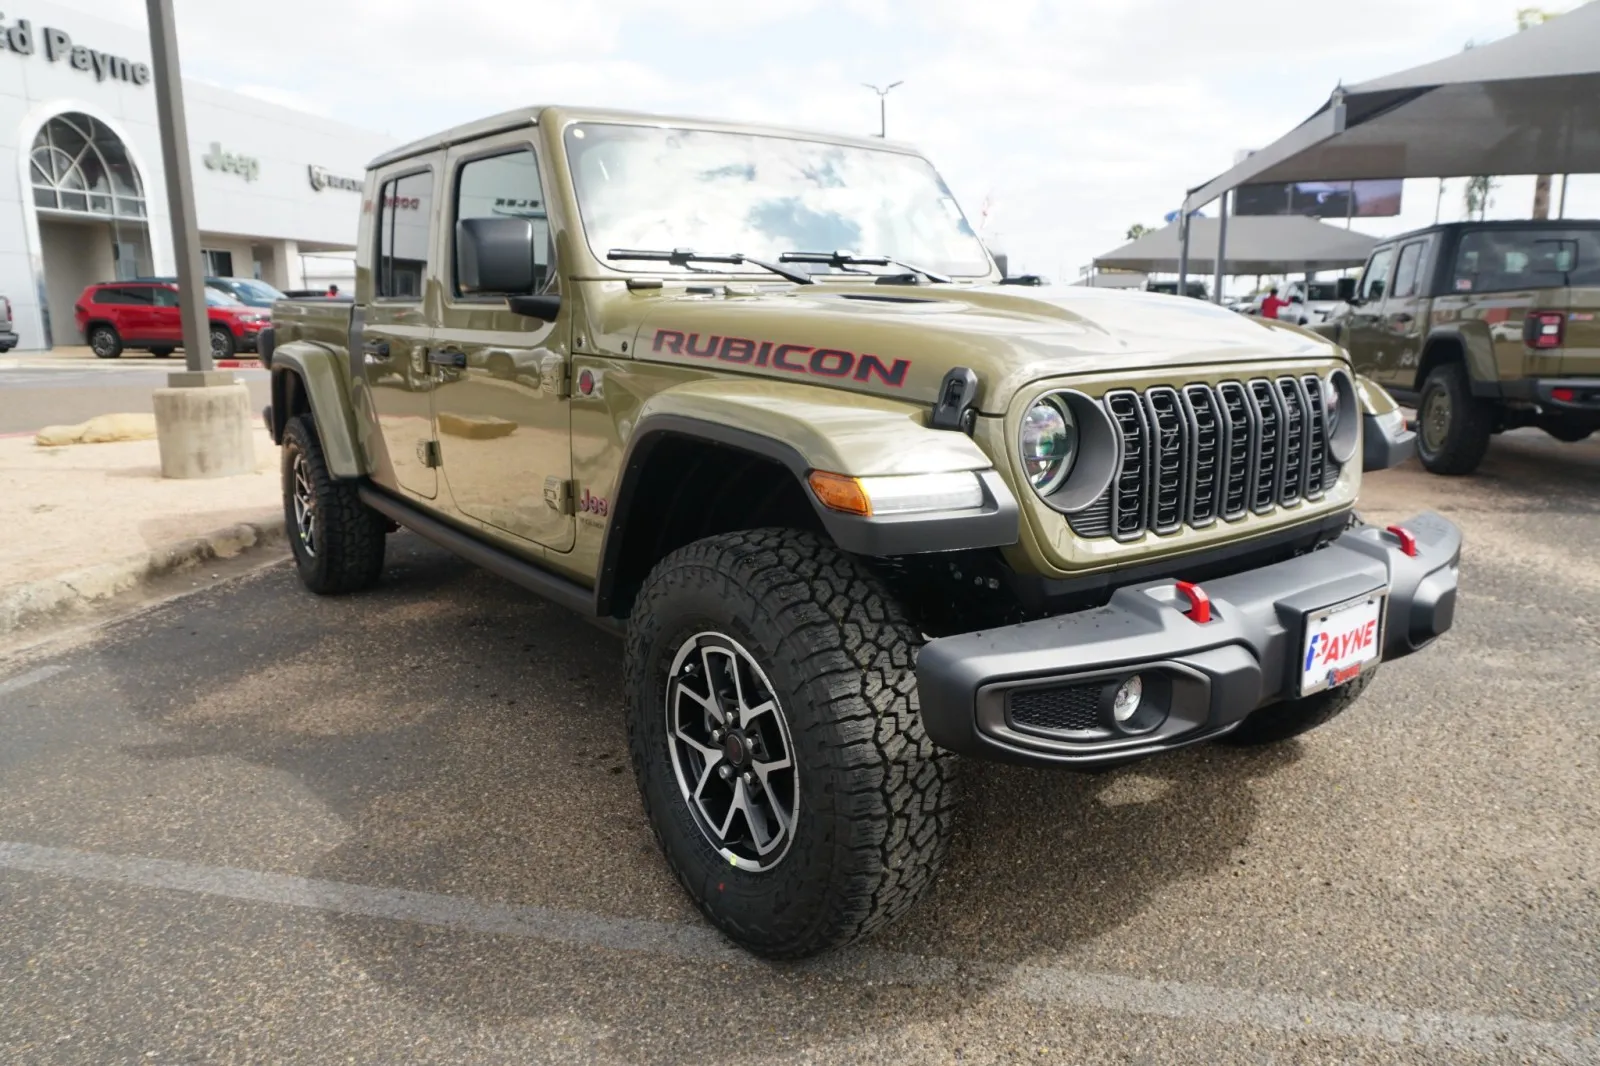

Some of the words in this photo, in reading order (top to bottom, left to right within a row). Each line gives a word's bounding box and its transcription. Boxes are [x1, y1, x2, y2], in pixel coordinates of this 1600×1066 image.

[0, 11, 34, 56] d
[43, 27, 150, 85] Payne
[202, 141, 259, 183] Jeep
[653, 329, 912, 387] RUBICON
[580, 488, 608, 517] Jee
[1305, 619, 1376, 672] PAYNE
